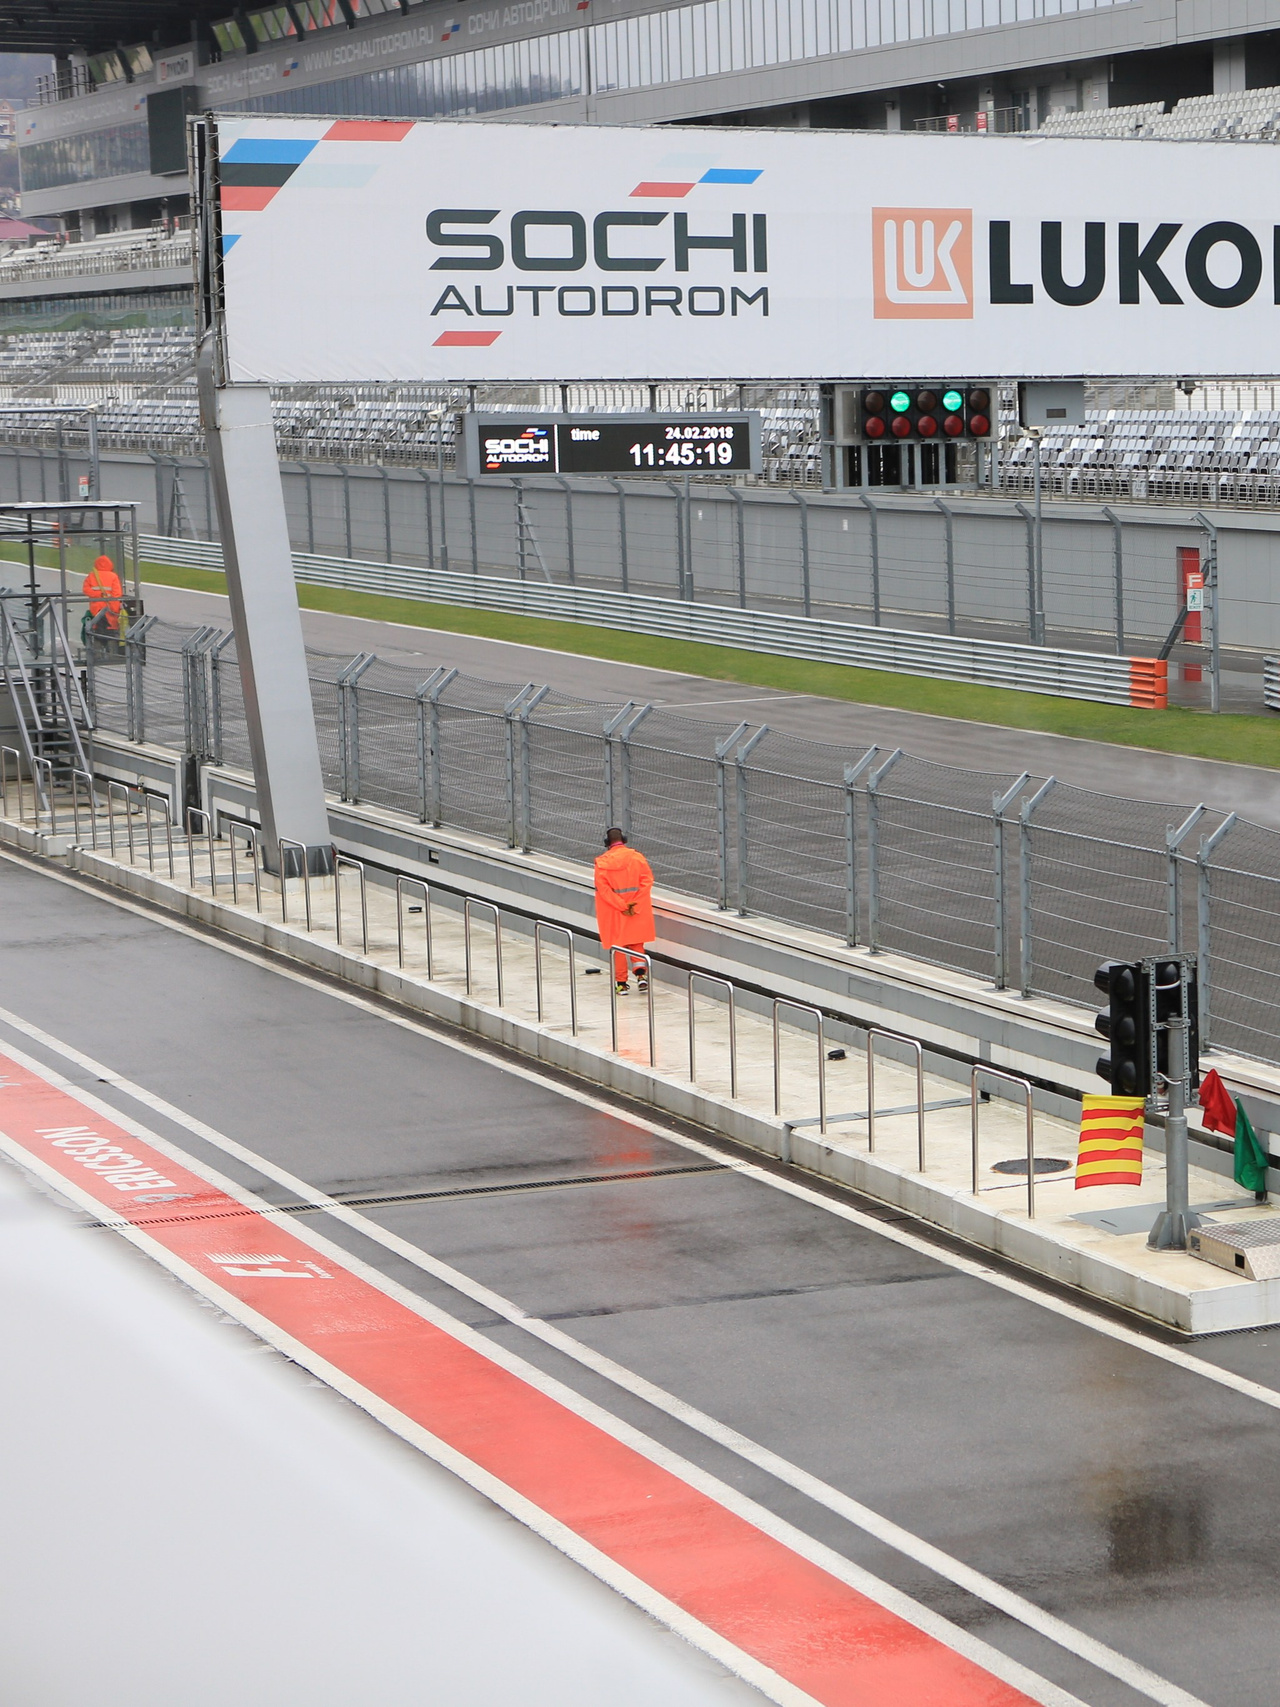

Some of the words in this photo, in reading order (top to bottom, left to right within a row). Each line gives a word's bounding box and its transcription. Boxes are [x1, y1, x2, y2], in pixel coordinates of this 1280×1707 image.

[468, 13, 498, 35] СОЧИ
[303, 25, 434, 72] WWW.SOCHIAUTODROM.RU
[426, 209, 767, 273] SOCHI
[430, 285, 769, 317] AUTODROM
[570, 428, 600, 441] time
[665, 426, 734, 440] 24.02.2018
[485, 439, 549, 454] SOCHI
[486, 453, 549, 462] AUTODROM
[629, 443, 733, 466] 11:45:19
[1189, 575, 1202, 587] F
[34, 1126, 177, 1191] ERICSSON
